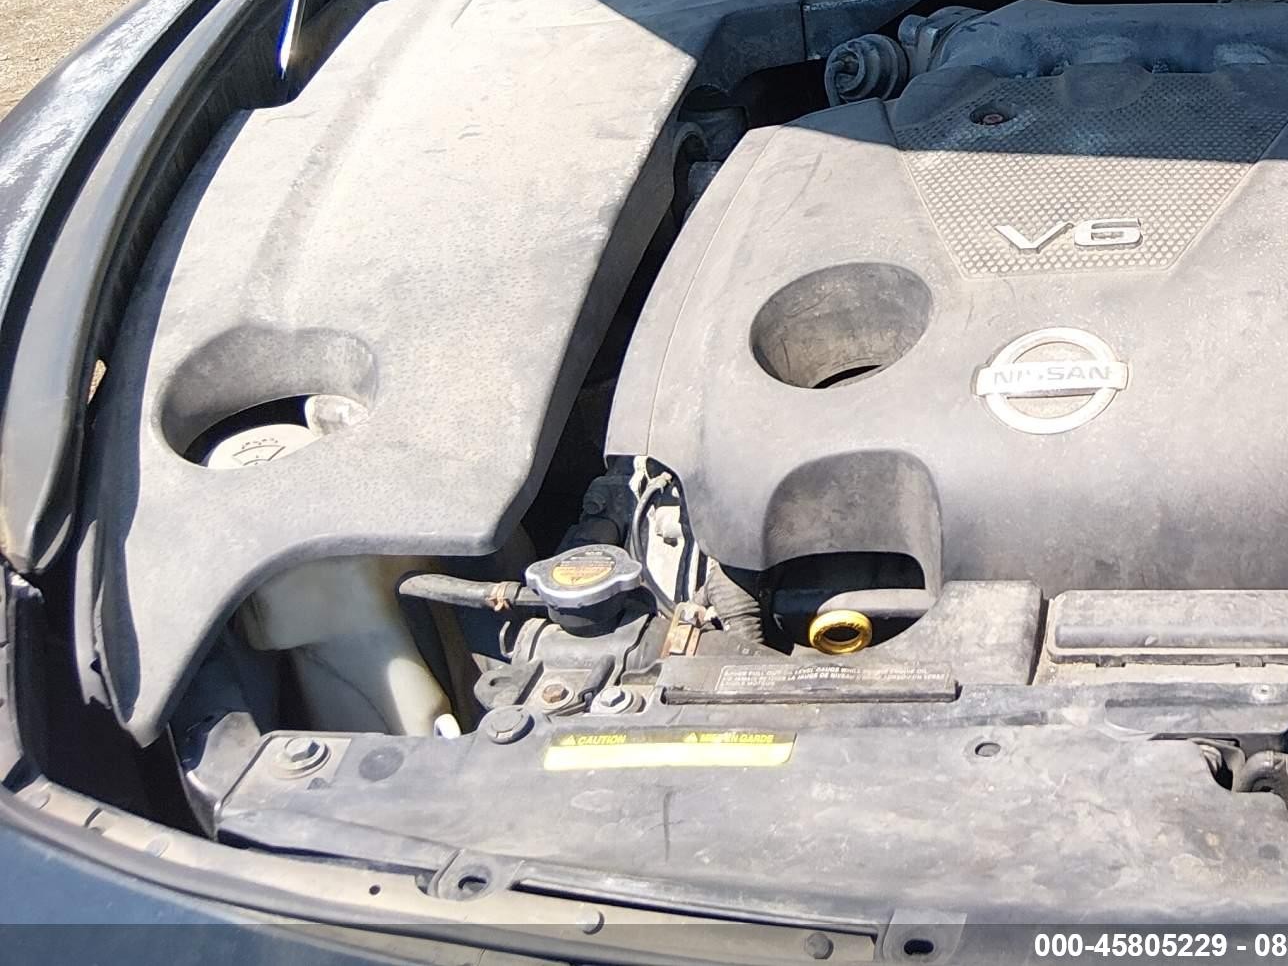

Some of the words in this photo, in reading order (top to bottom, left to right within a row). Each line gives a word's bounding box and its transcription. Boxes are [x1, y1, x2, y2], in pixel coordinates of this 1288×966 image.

[994, 218, 1143, 253] V6
[577, 734, 626, 745] CAUTION
[740, 734, 774, 743] GARDE
